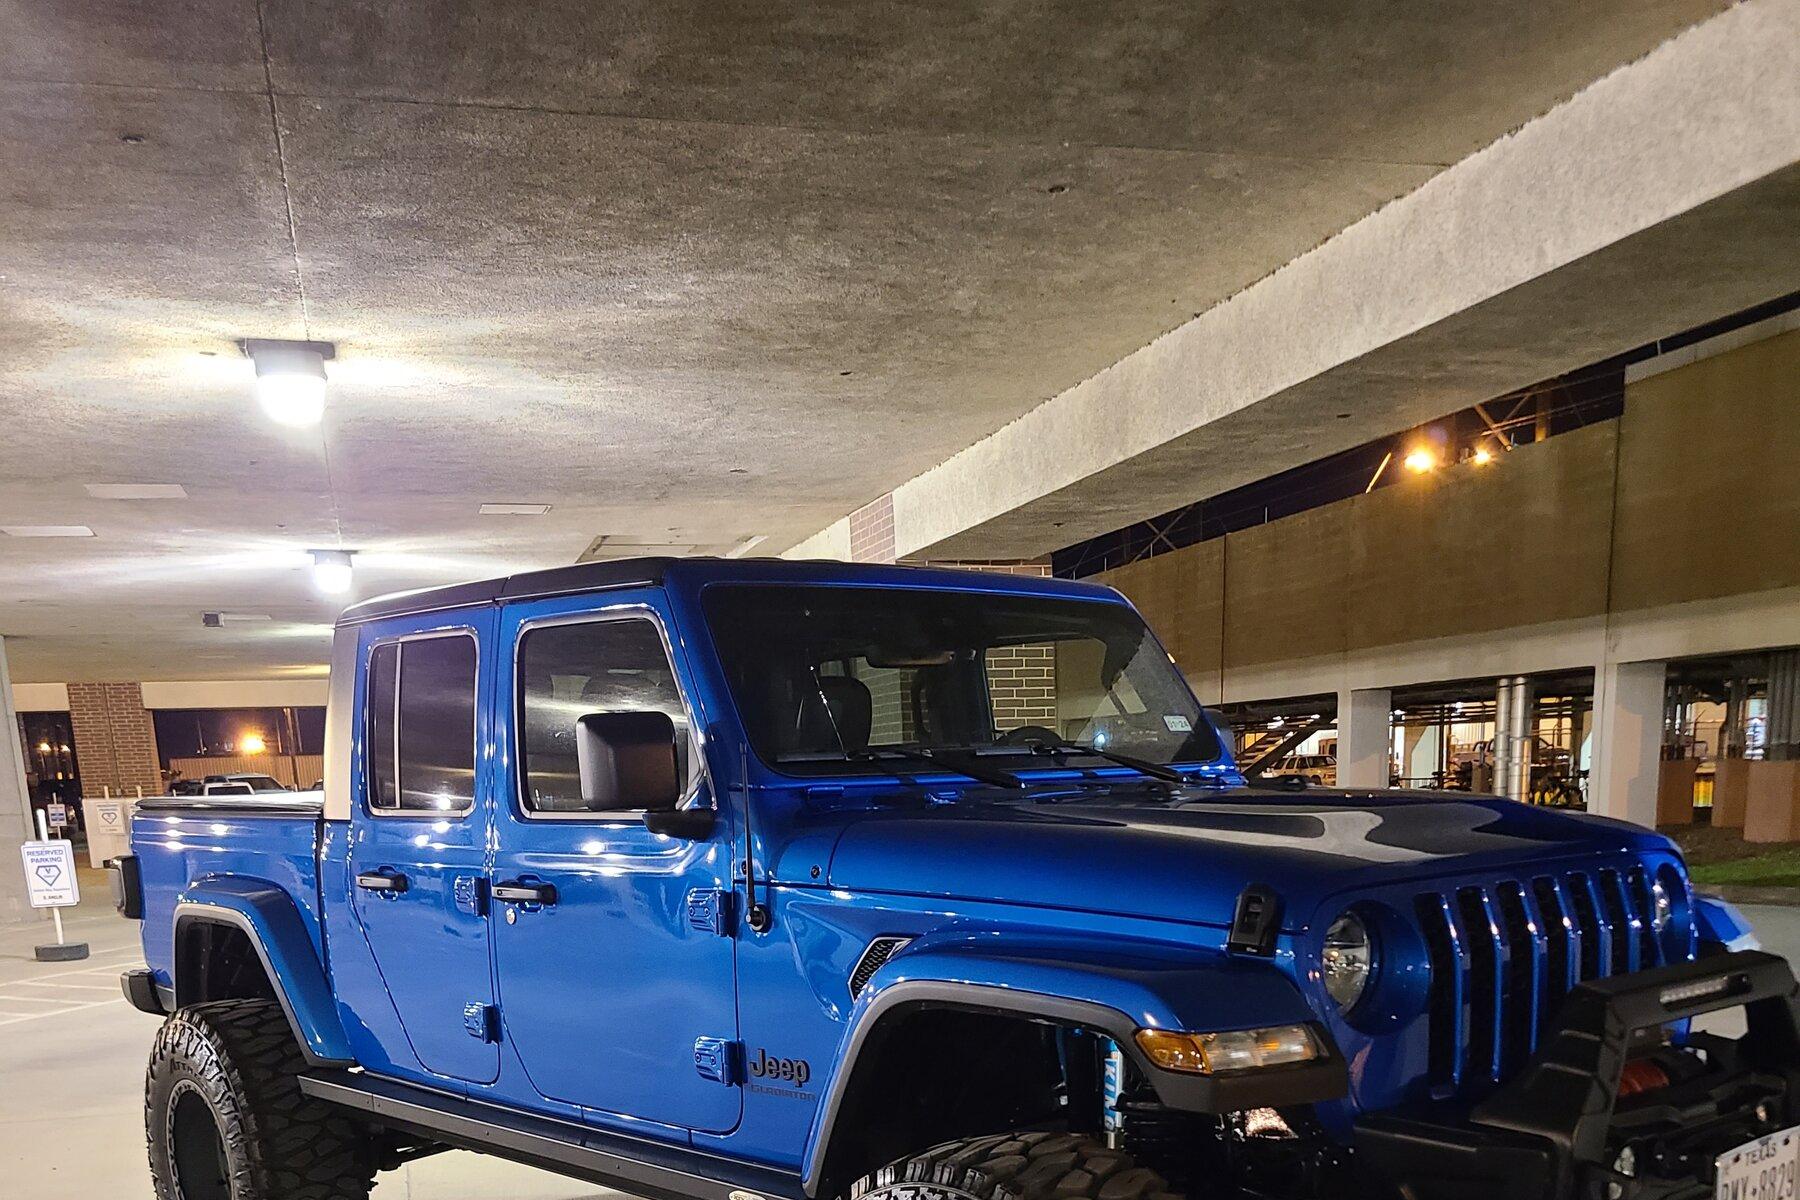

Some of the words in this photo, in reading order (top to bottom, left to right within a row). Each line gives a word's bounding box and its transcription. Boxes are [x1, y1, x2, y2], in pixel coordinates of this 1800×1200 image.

[749, 1048, 811, 1088] Jeep
[750, 1084, 816, 1101] GLADIATOR
[1745, 1142, 1777, 1166] TEXAS
